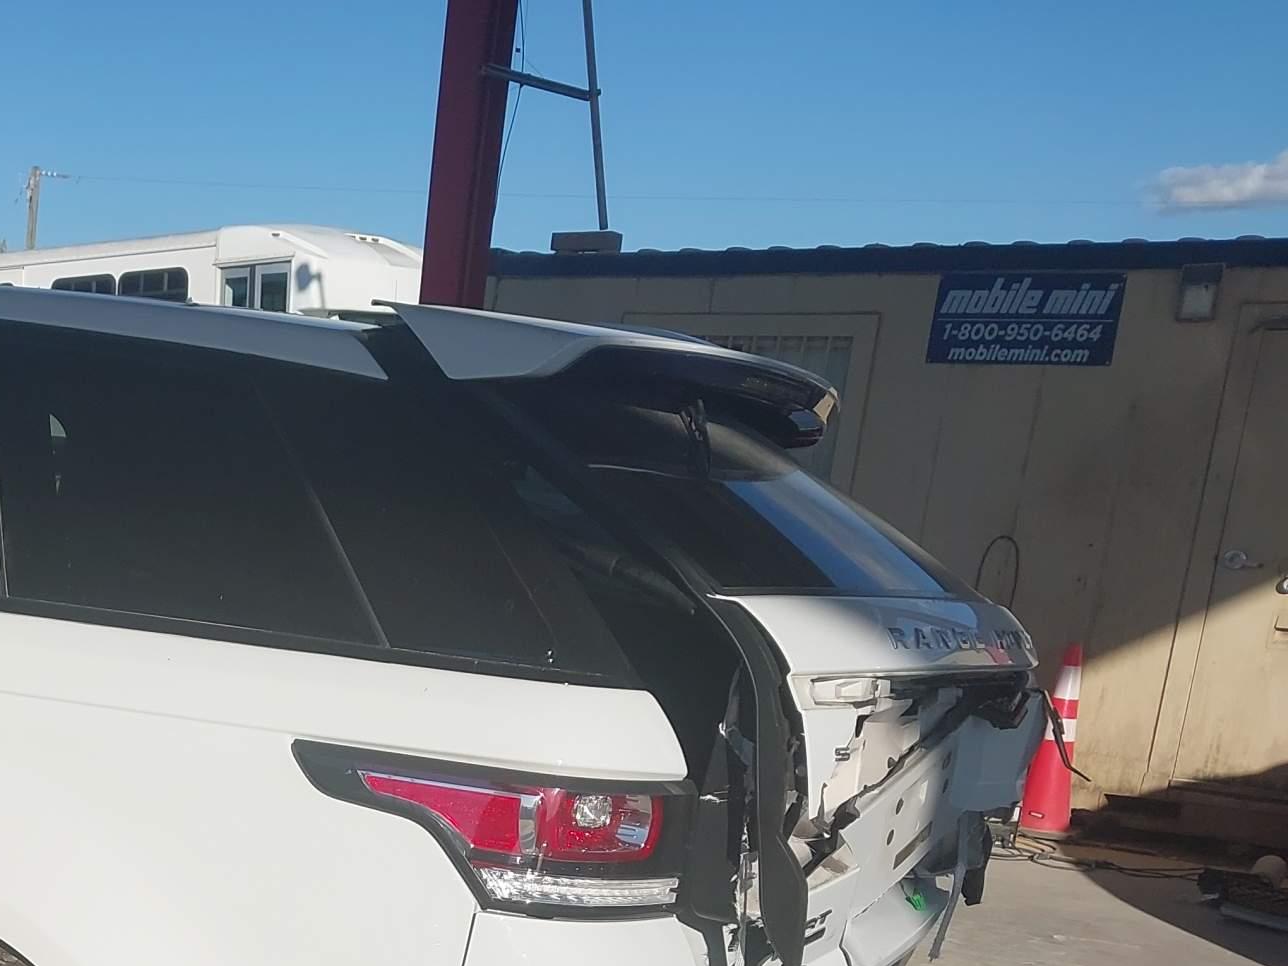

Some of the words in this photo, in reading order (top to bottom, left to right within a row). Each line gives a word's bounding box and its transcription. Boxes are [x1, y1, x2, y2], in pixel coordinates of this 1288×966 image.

[940, 277, 1044, 315] mobile
[1043, 283, 1120, 315] mini
[942, 323, 1104, 342] 1-800-950-6464
[947, 344, 1090, 363] mobilemini.com
[888, 627, 986, 650] RANGE
